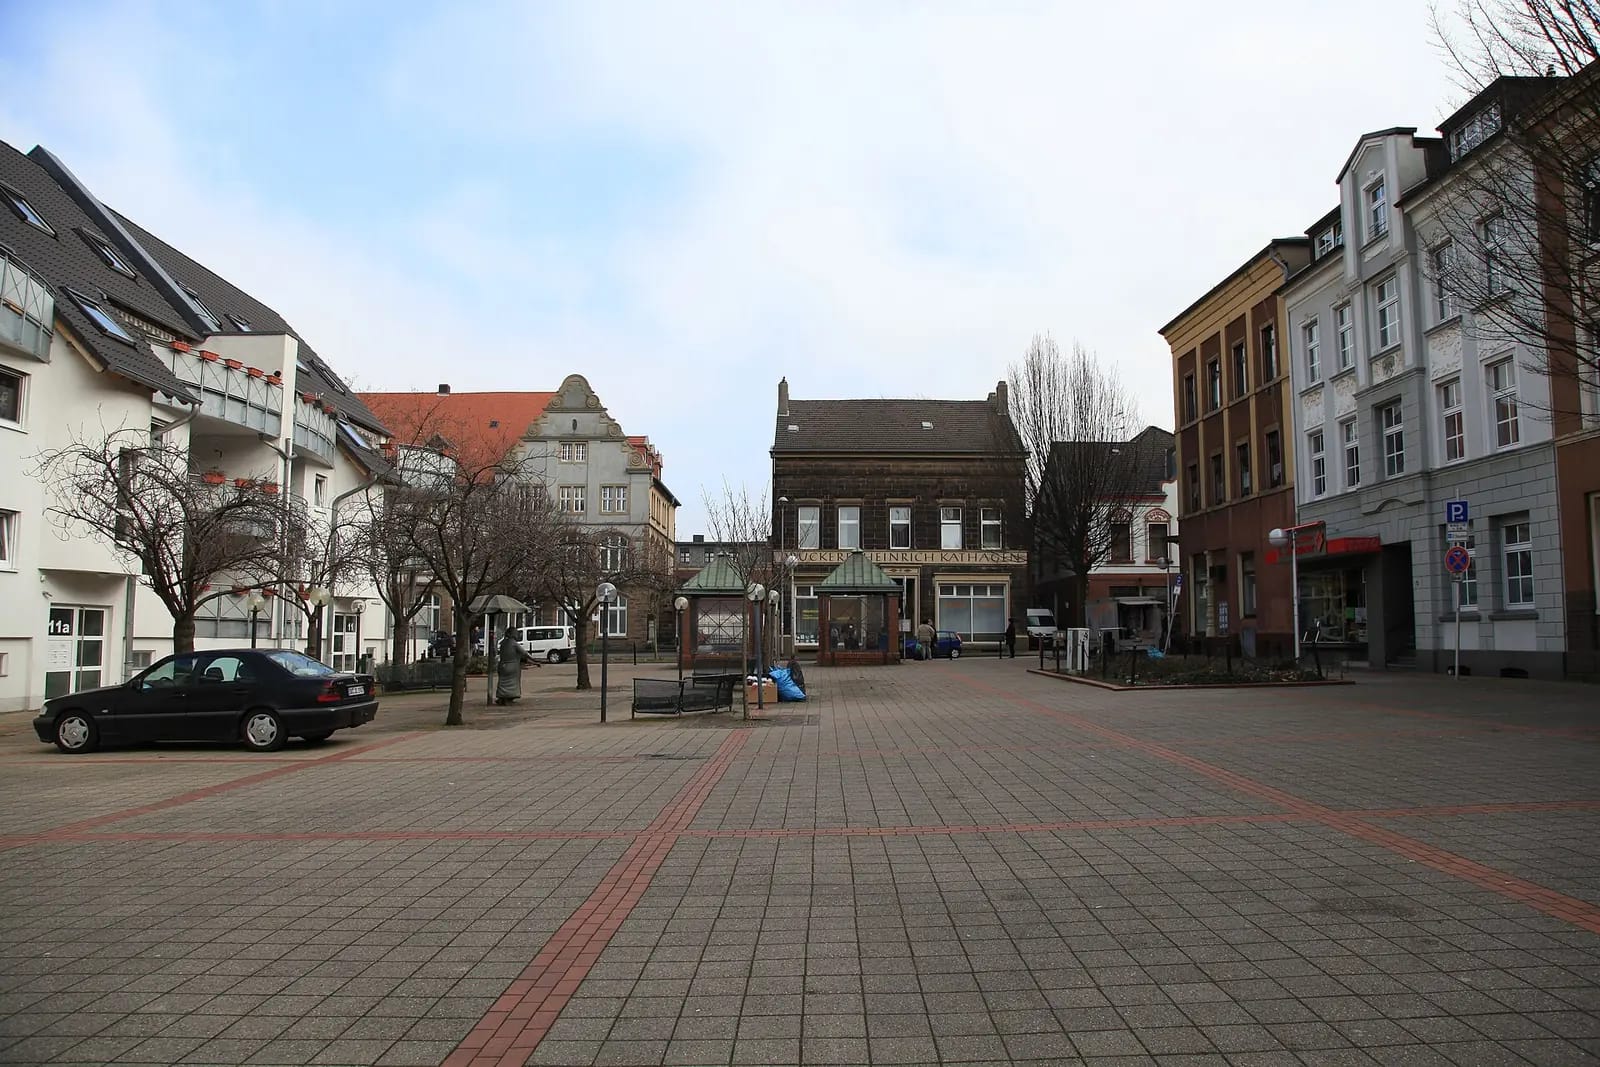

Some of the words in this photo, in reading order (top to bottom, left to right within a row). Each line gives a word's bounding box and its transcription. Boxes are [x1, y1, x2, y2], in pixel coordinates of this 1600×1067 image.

[1451, 503, 1464, 521] P
[863, 552, 934, 562] HEINRICH
[48, 620, 70, 633] 11a
[347, 622, 354, 631] 11
